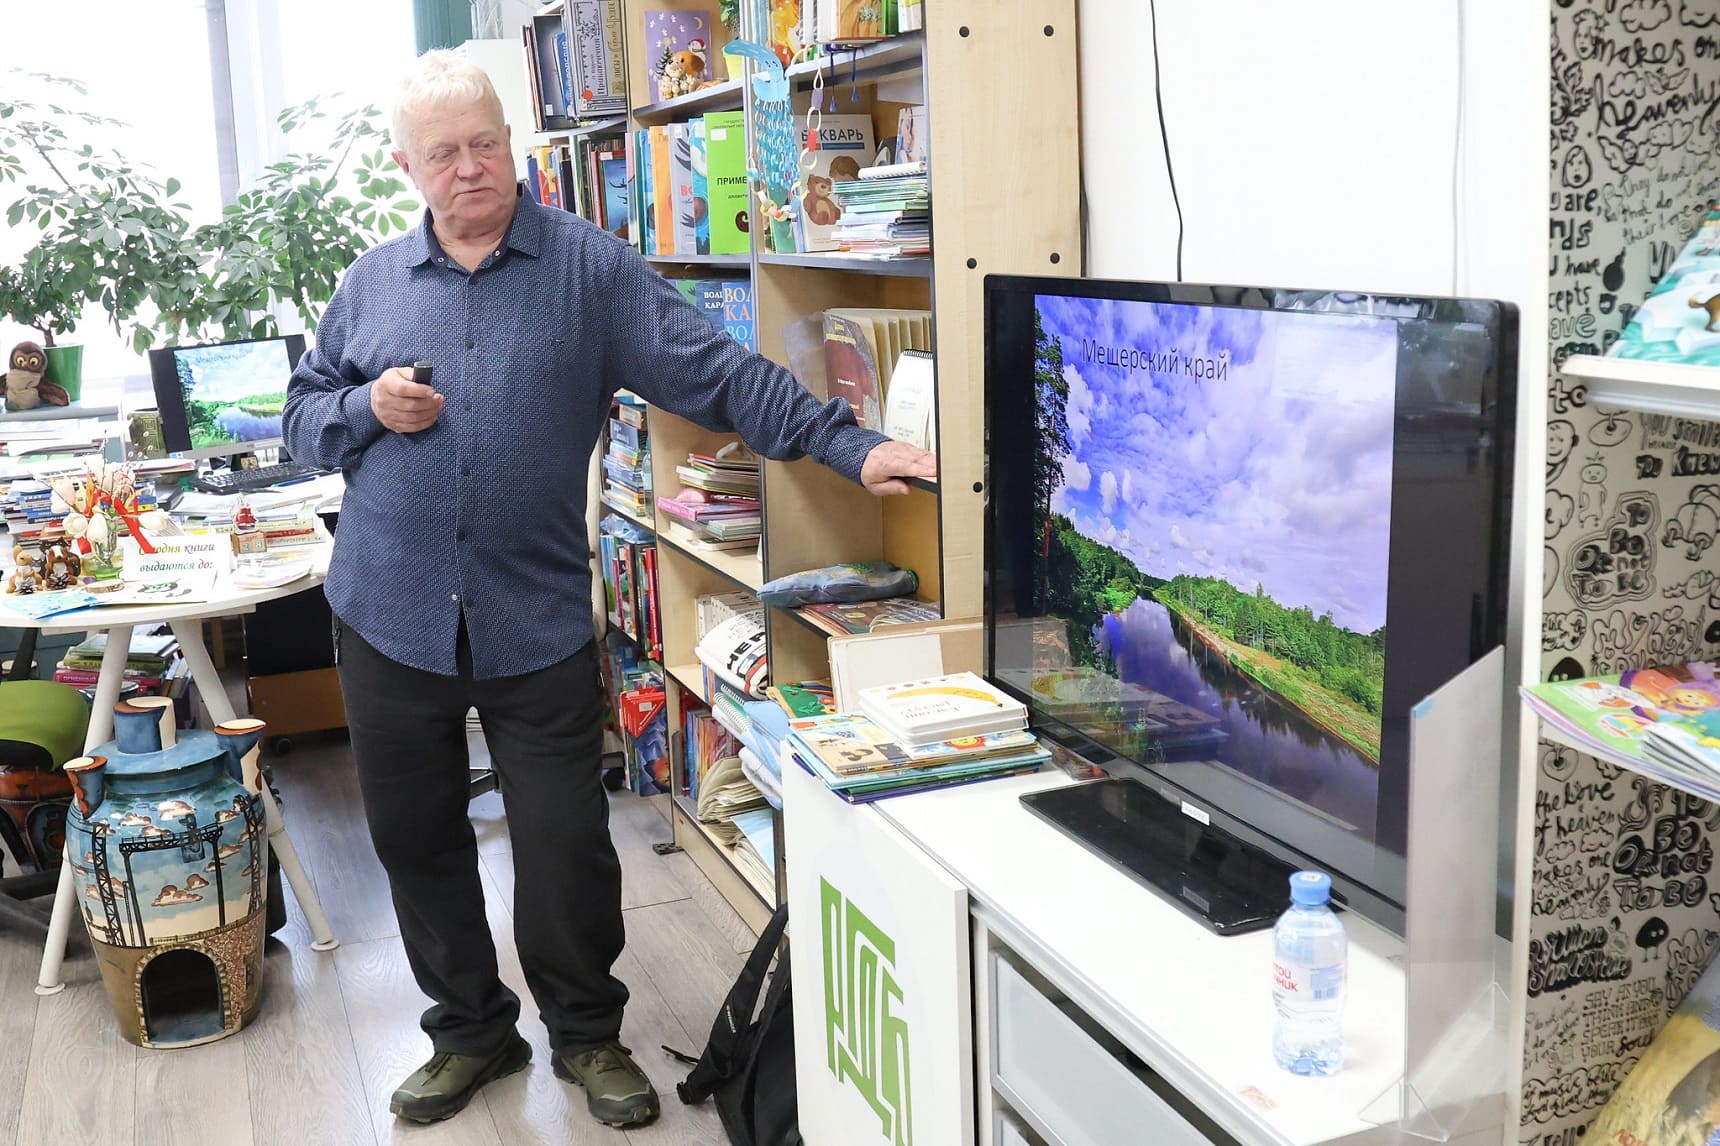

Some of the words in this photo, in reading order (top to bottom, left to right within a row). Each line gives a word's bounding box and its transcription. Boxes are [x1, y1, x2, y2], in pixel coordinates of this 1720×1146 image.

[801, 129, 864, 142] БКВАРЬ
[1082, 338, 1179, 375] Мещерский
[1184, 353, 1228, 384] край
[184, 542, 215, 555] книги
[139, 561, 195, 573] выдаются
[198, 559, 214, 570] до:
